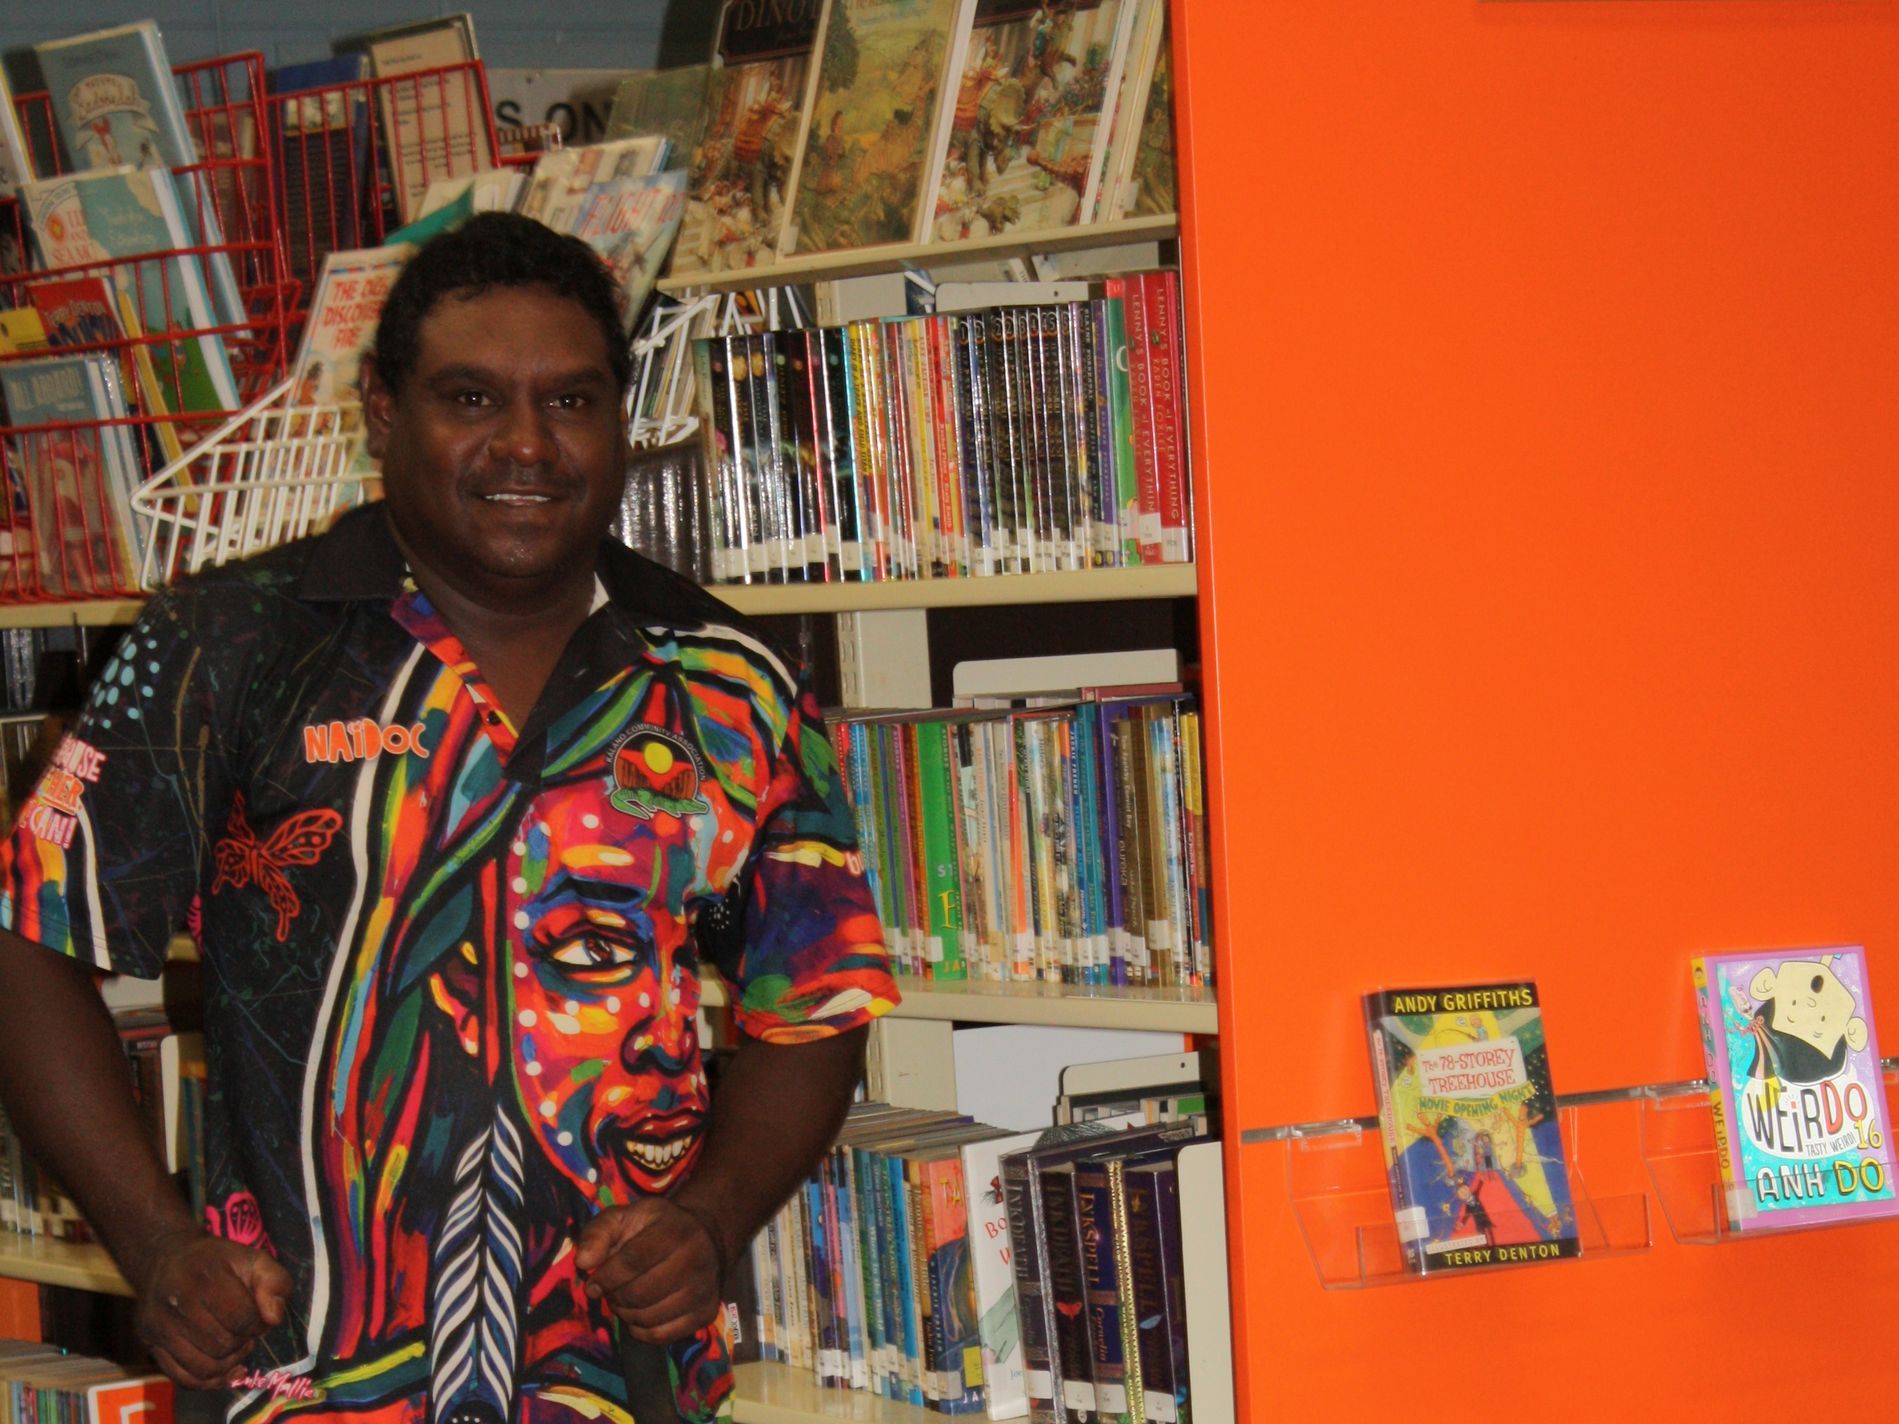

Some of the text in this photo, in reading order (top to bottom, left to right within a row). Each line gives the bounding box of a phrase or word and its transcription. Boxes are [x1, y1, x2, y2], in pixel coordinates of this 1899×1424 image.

[1138, 363, 1149, 406] BOOK
[1162, 358, 1172, 400] BOOK
[1143, 431, 1156, 512] EVERYTHIN
[1166, 424, 1179, 520] EVERYTHING
[1394, 989, 1533, 1013] ANDY GRIFFITHS
[1440, 1048, 1516, 1070] 78-STOREY
[1419, 1085, 1534, 1117] MOVIE OPENING NIGHT
[1428, 1069, 1517, 1095] TREEHOUSE
[1805, 1142, 1828, 1157] TASTY
[1854, 1120, 1883, 1150] 16
[1757, 1157, 1885, 1203] ANH DO
[1007, 1184, 1028, 1280] INKDEATH
[1080, 1191, 1101, 1286] INKSPELL
[1445, 1244, 1561, 1266] TERRY DENTON
[869, 1225, 879, 1259] Where
[875, 1299, 885, 1330] World
[1096, 1306, 1108, 1361] Cornelia
